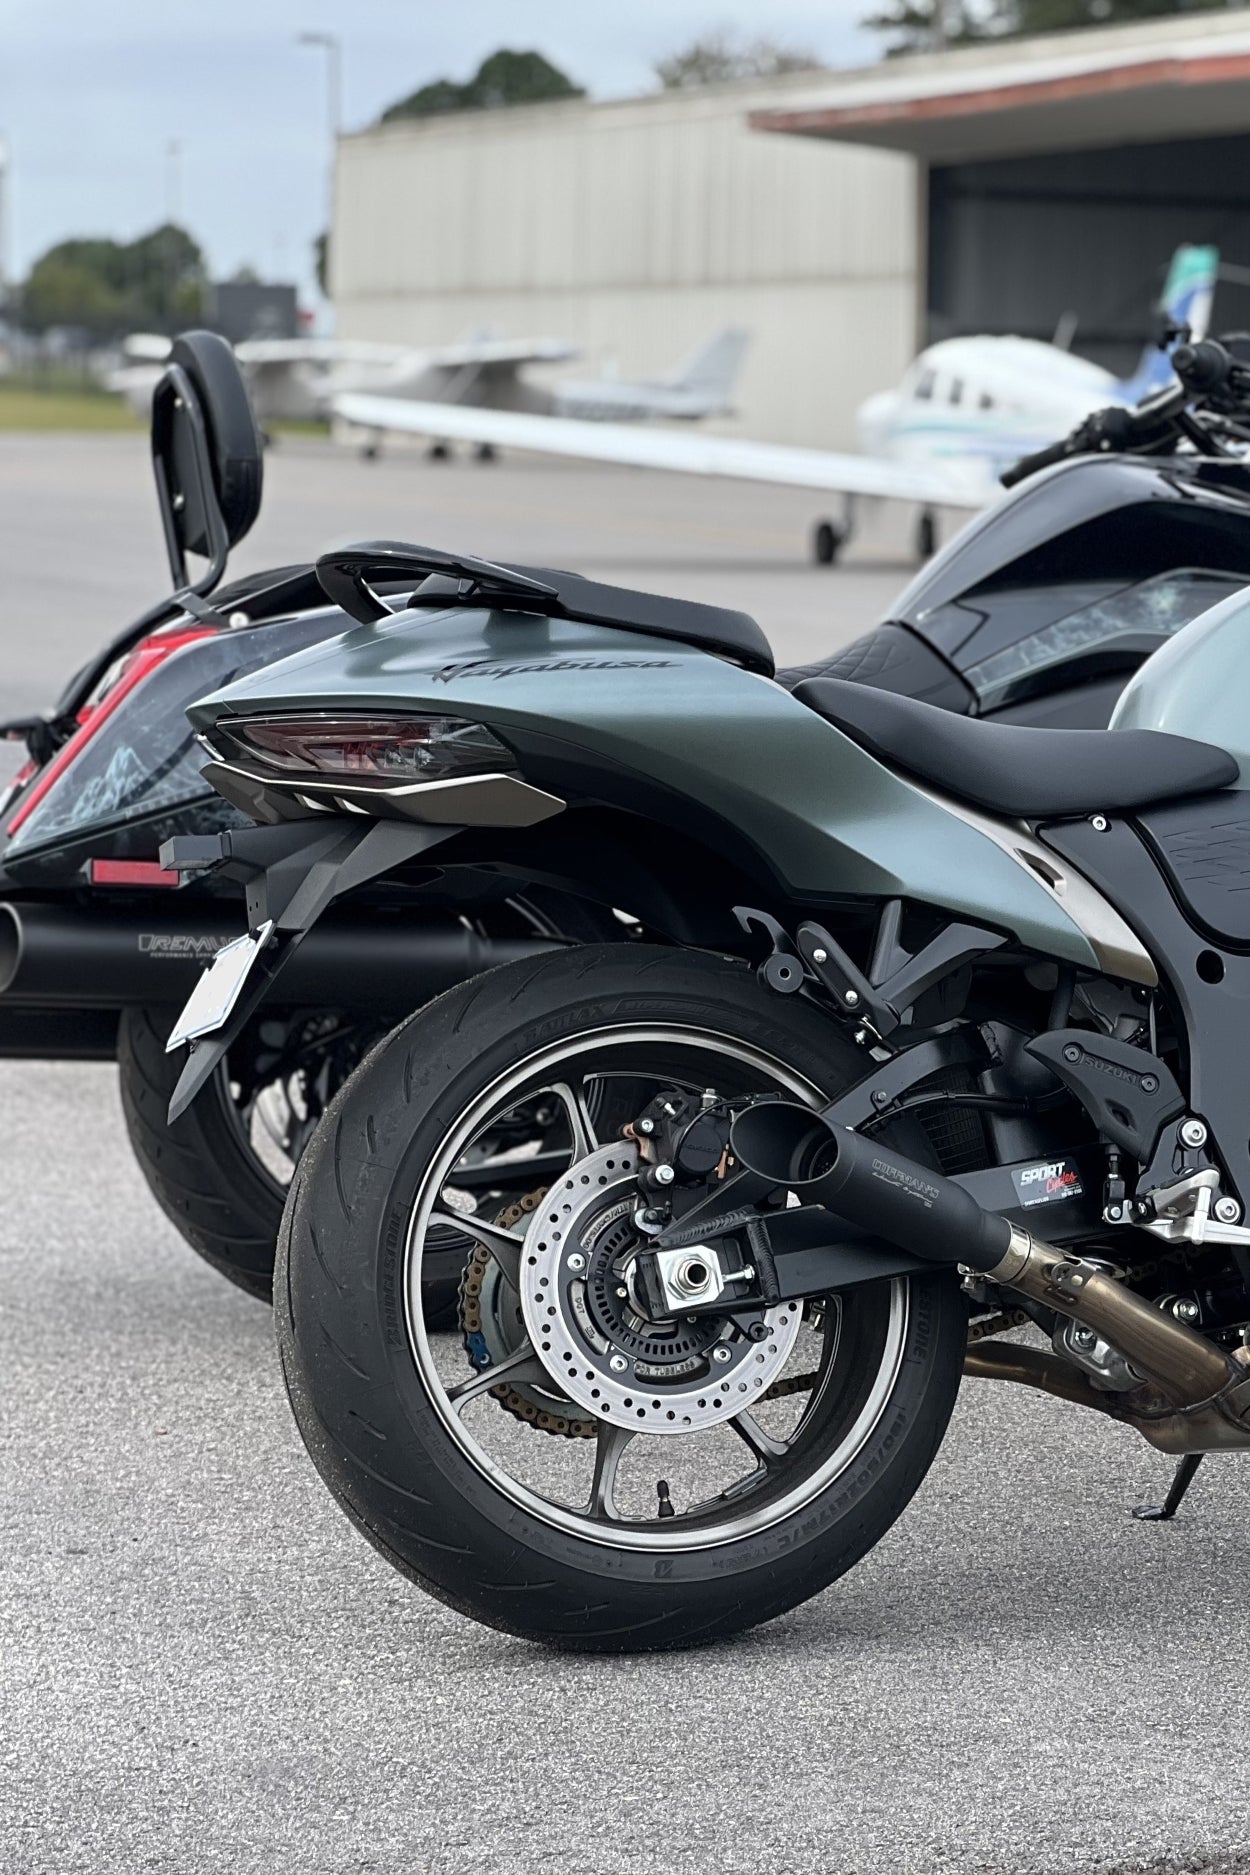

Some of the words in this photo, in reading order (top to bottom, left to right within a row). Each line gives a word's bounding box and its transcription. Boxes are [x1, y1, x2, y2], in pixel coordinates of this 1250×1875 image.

[431, 657, 684, 683] Hayabusa
[1084, 1055, 1138, 1085] SUZUKI
[1020, 1161, 1066, 1186] SPORT
